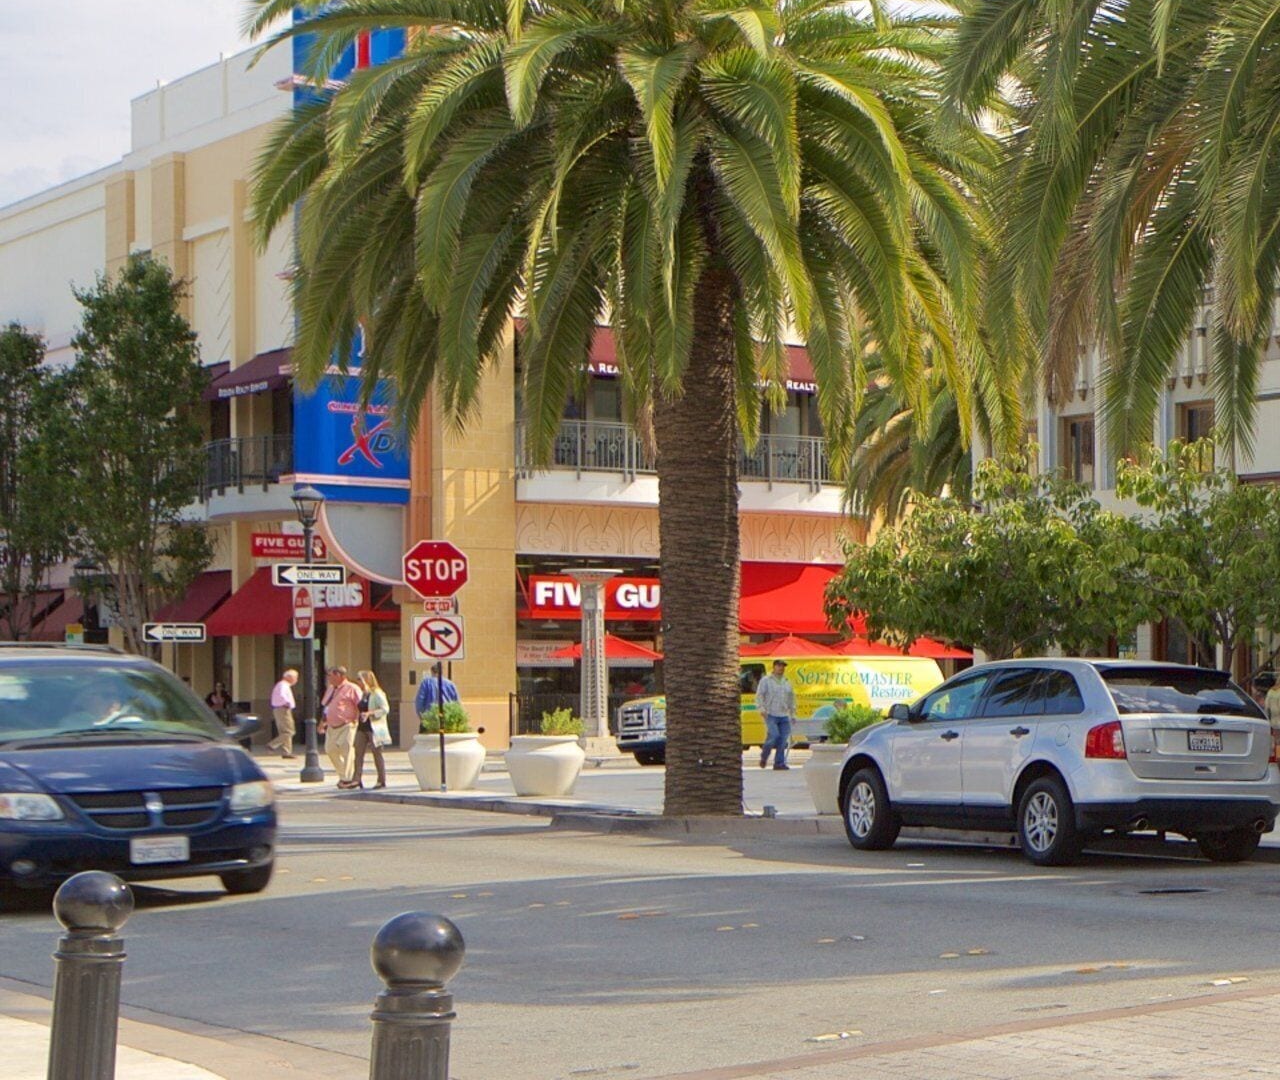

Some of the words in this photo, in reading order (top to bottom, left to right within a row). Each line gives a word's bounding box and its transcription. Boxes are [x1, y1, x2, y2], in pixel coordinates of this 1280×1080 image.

[255, 537, 285, 547] FIVE
[288, 538, 322, 548] GUS
[297, 571, 314, 579] ONE
[319, 571, 338, 579] WAY
[407, 559, 465, 581] STOP
[326, 582, 363, 608] GUYS
[535, 581, 583, 607] FIV
[616, 583, 661, 609] GU
[181, 628, 198, 636] WAY
[871, 686, 913, 698] Restore
